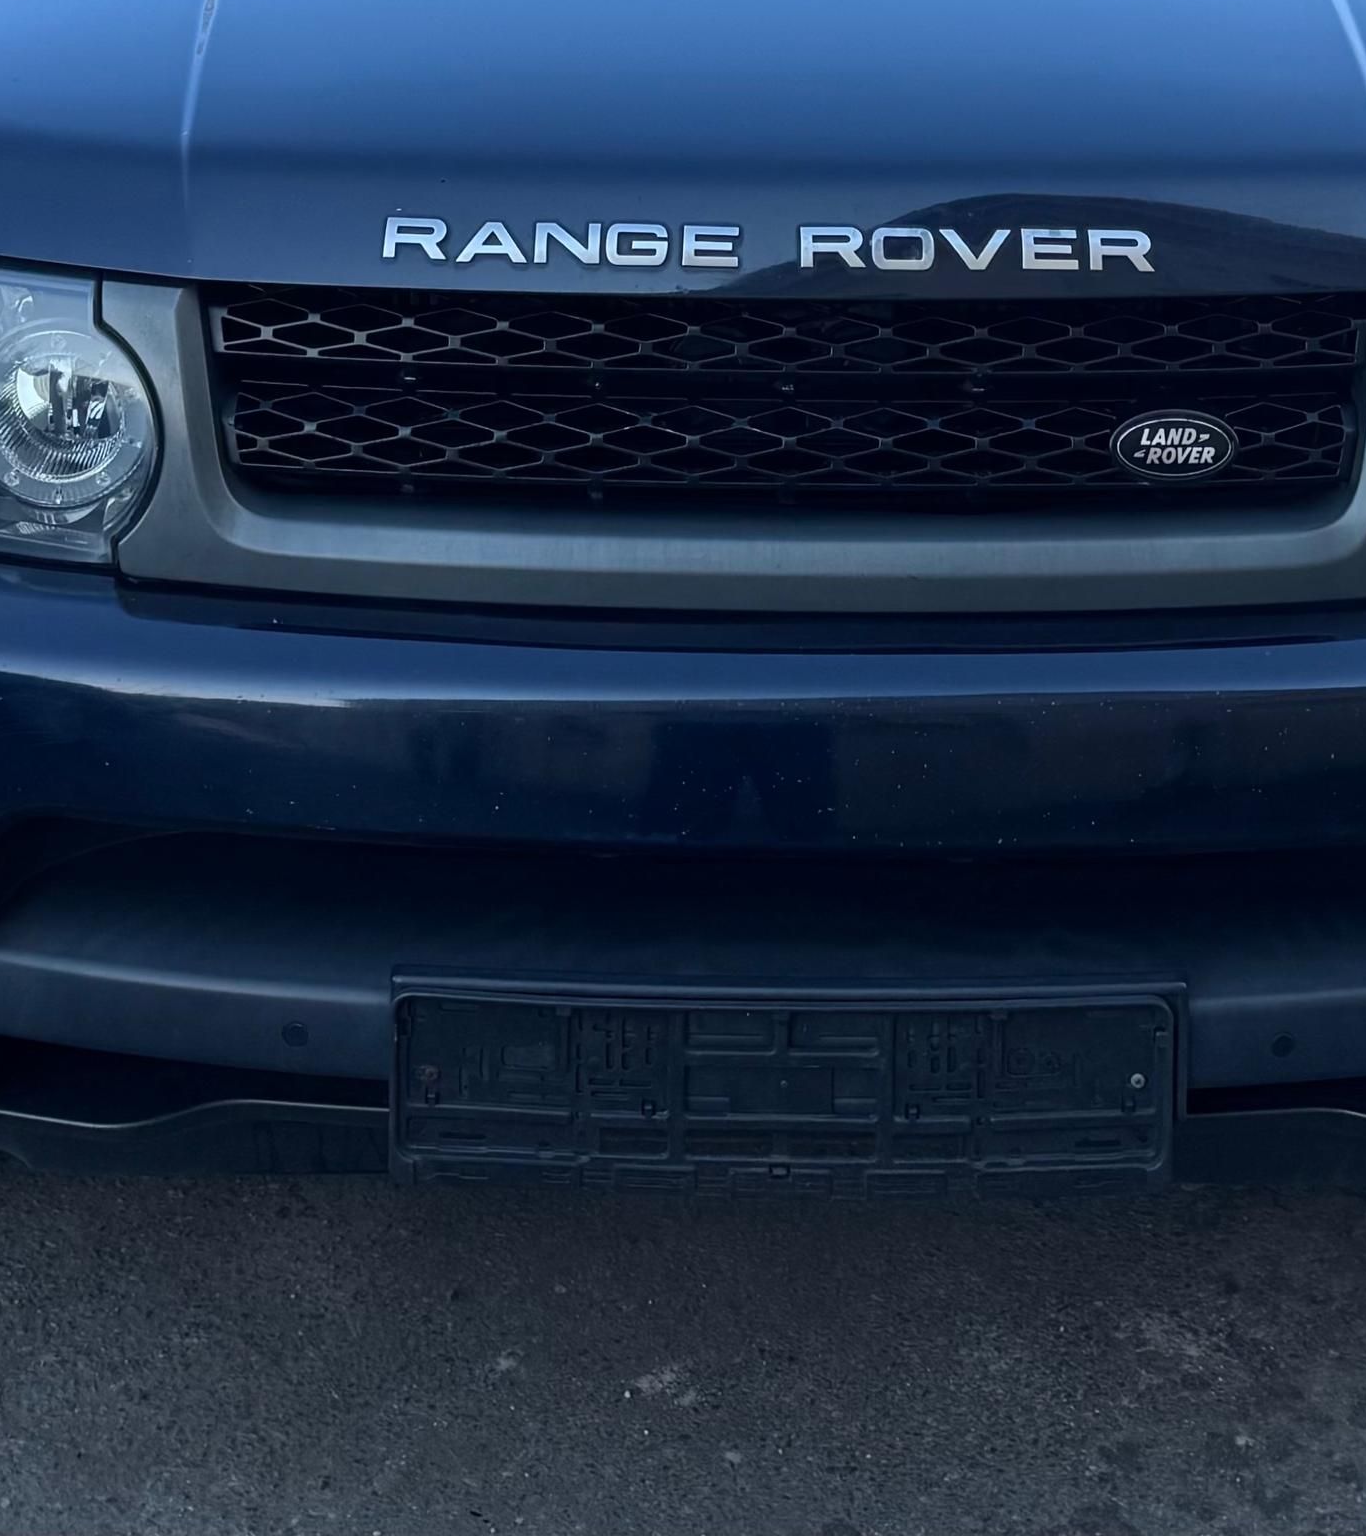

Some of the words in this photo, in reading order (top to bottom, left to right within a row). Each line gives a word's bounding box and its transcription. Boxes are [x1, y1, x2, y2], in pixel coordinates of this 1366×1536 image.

[382, 216, 740, 268] RANGE
[799, 225, 1156, 273] ROVER
[1140, 428, 1197, 446] LAND
[1146, 446, 1216, 465] ROVER
